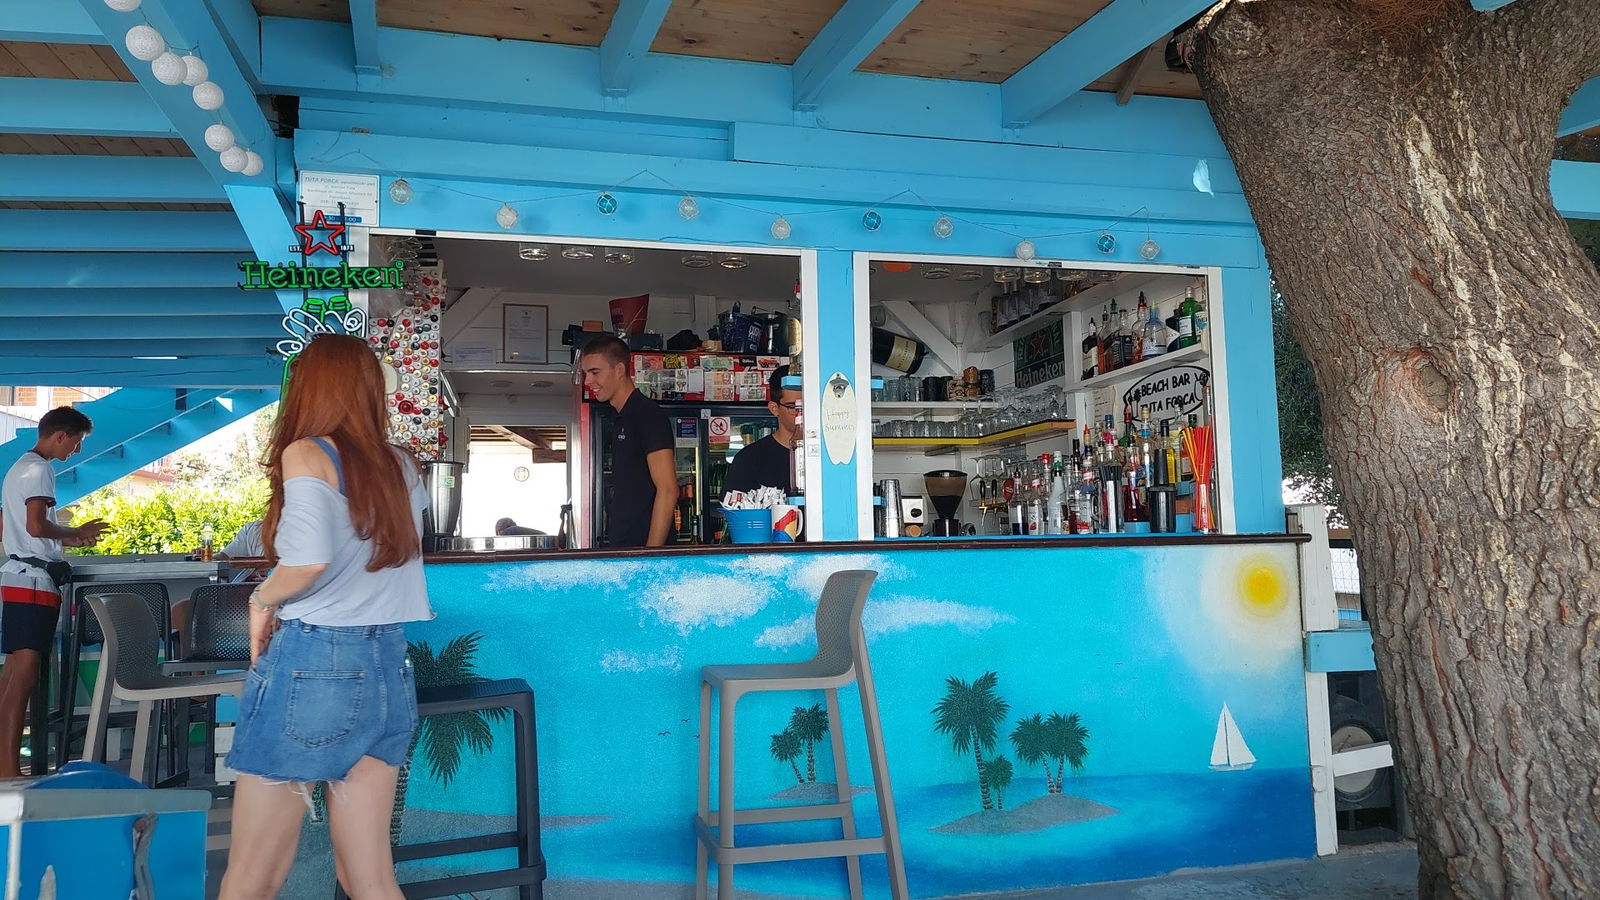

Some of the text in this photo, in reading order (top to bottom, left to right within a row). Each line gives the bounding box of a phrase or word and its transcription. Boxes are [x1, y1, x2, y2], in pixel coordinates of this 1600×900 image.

[241, 261, 405, 289] Heineken
[1015, 360, 1065, 388] Heineken
[1141, 372, 1191, 397] BEACH BAR
